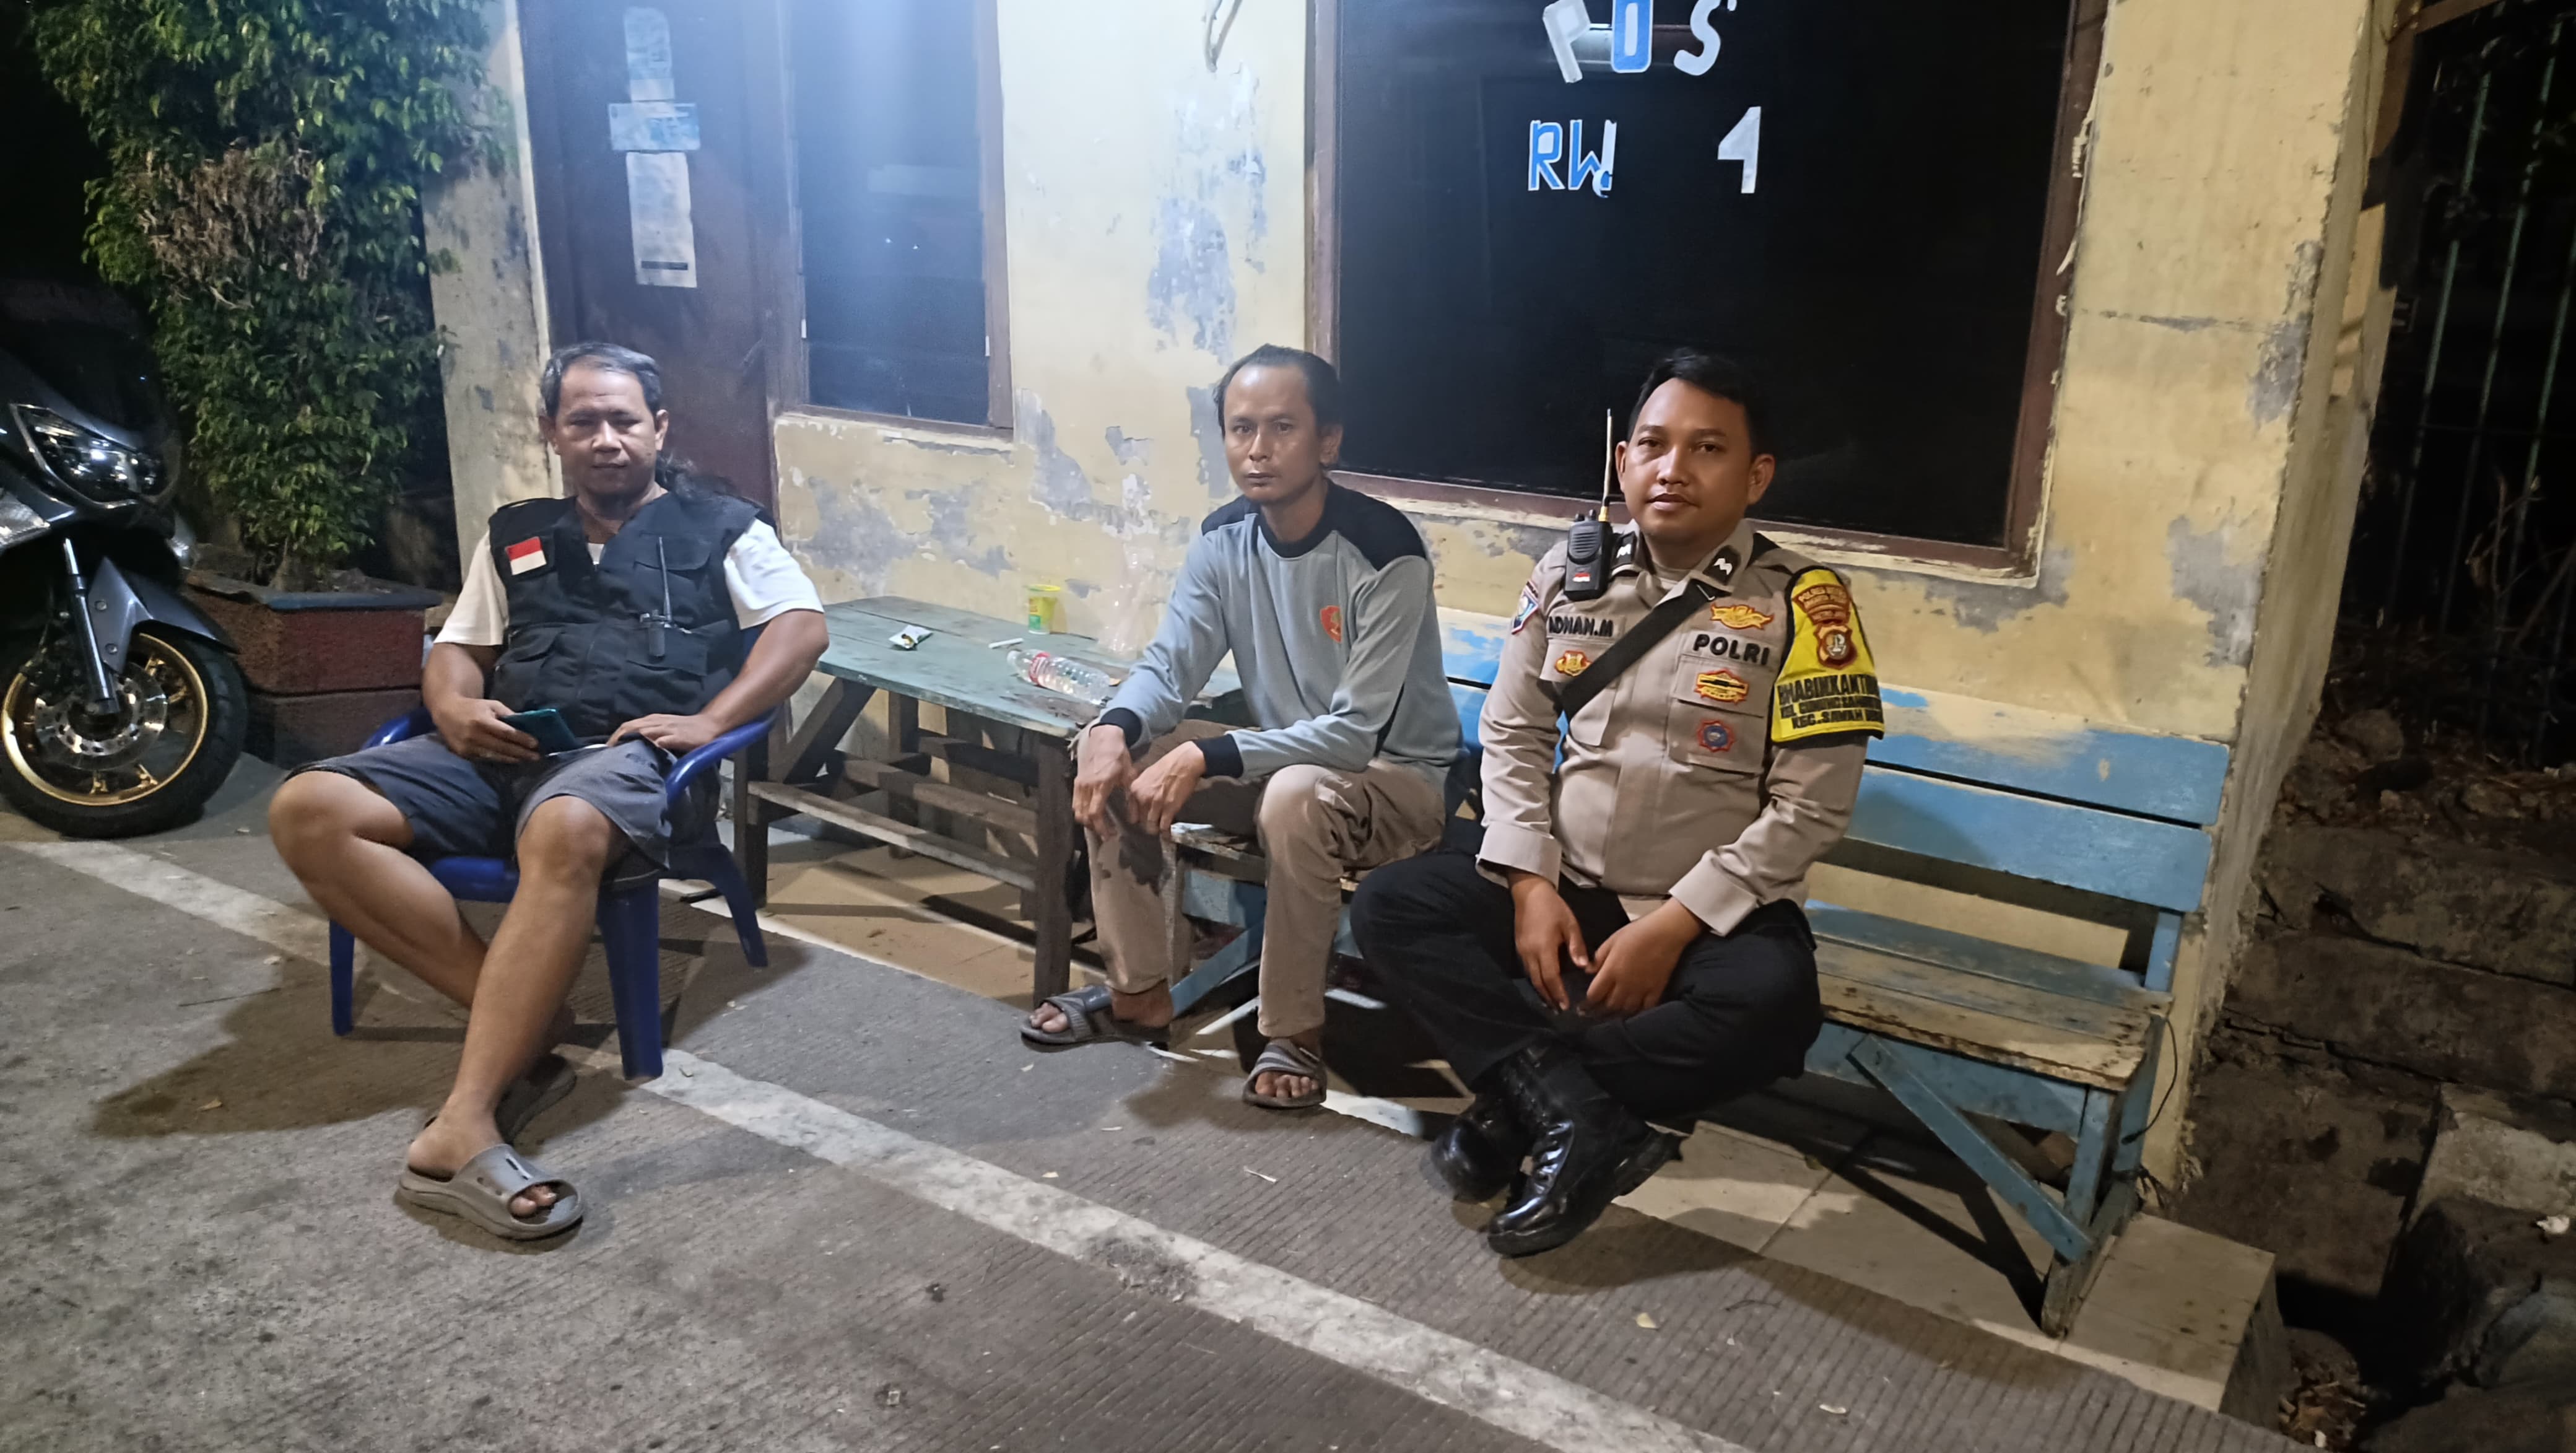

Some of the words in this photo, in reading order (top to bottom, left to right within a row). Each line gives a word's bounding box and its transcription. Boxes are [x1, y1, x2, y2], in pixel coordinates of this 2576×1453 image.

[1543, 0, 1738, 83] POS
[1528, 119, 1617, 198] RW
[1717, 106, 1761, 193] 1
[1693, 634, 1770, 666] POLRI
